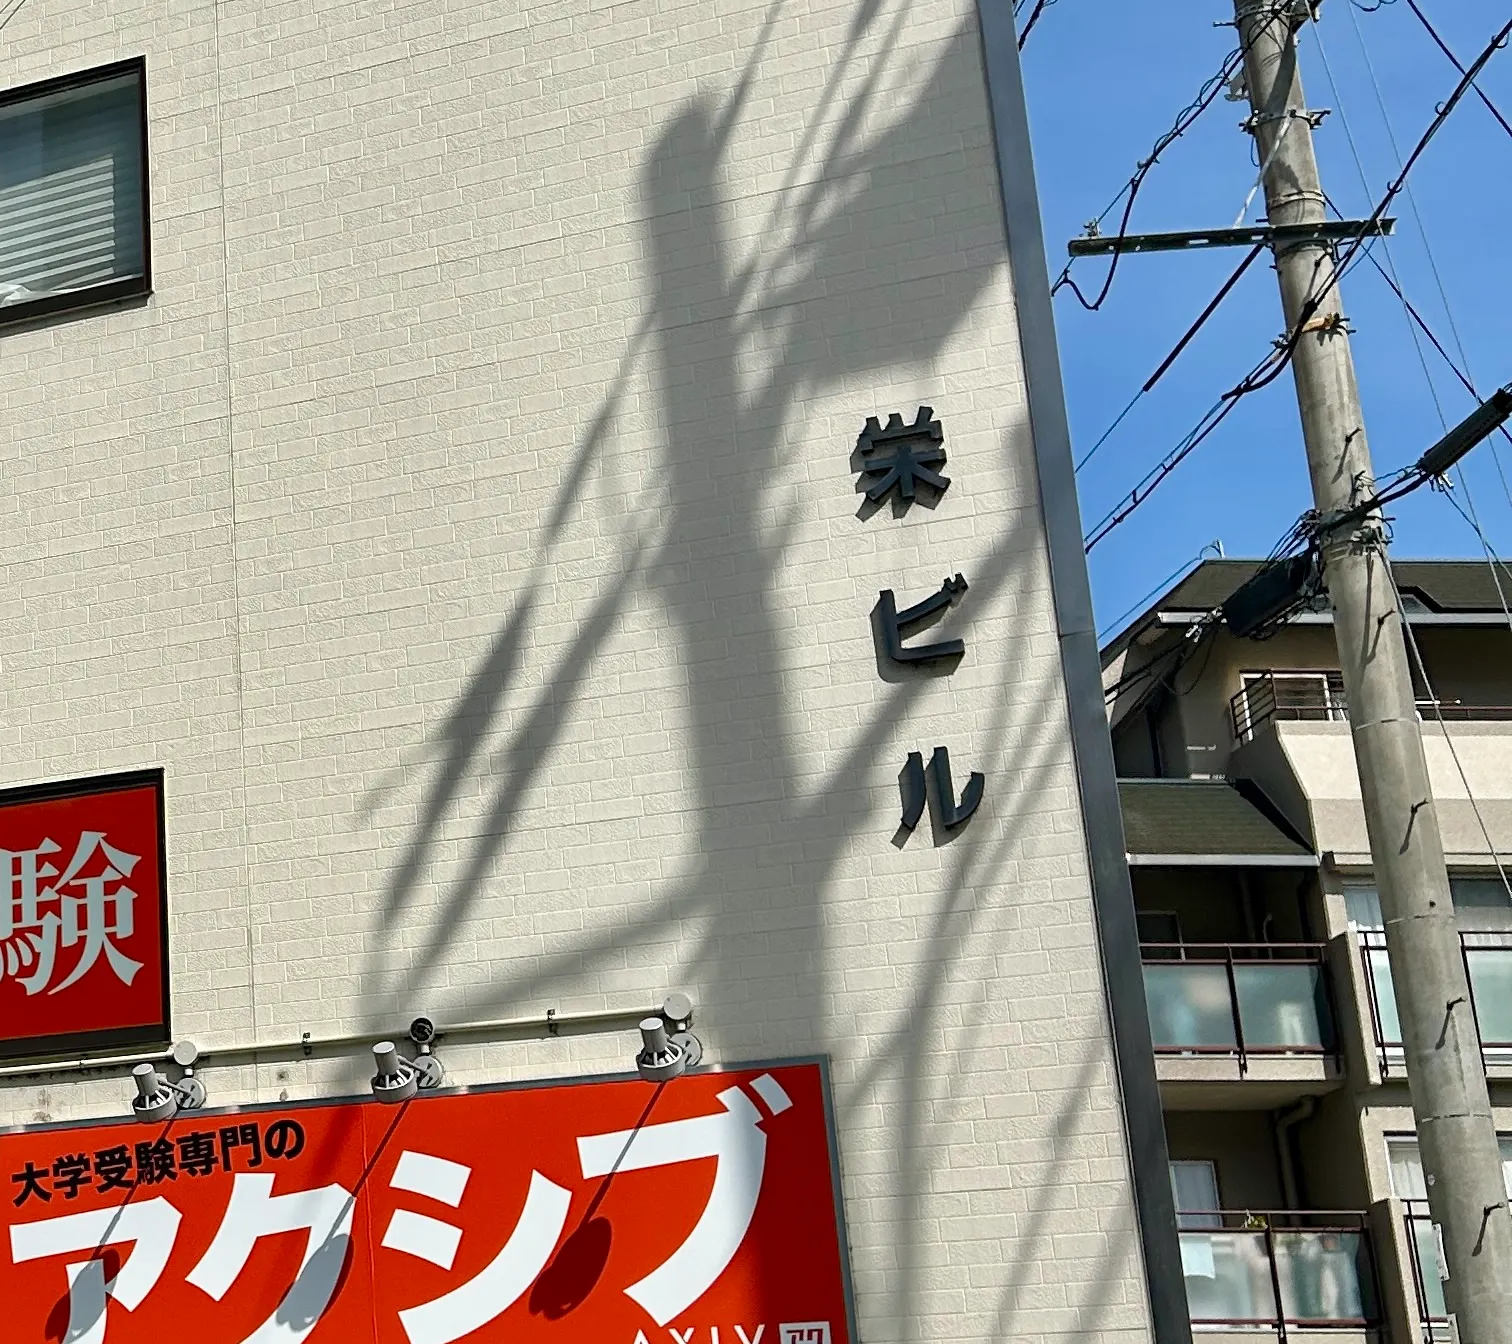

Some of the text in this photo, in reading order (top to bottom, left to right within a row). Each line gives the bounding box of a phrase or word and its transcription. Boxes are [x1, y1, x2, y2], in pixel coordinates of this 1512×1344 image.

[860, 404, 985, 833] 栄ビル
[10, 1118, 306, 1207] 大学受験専門の
